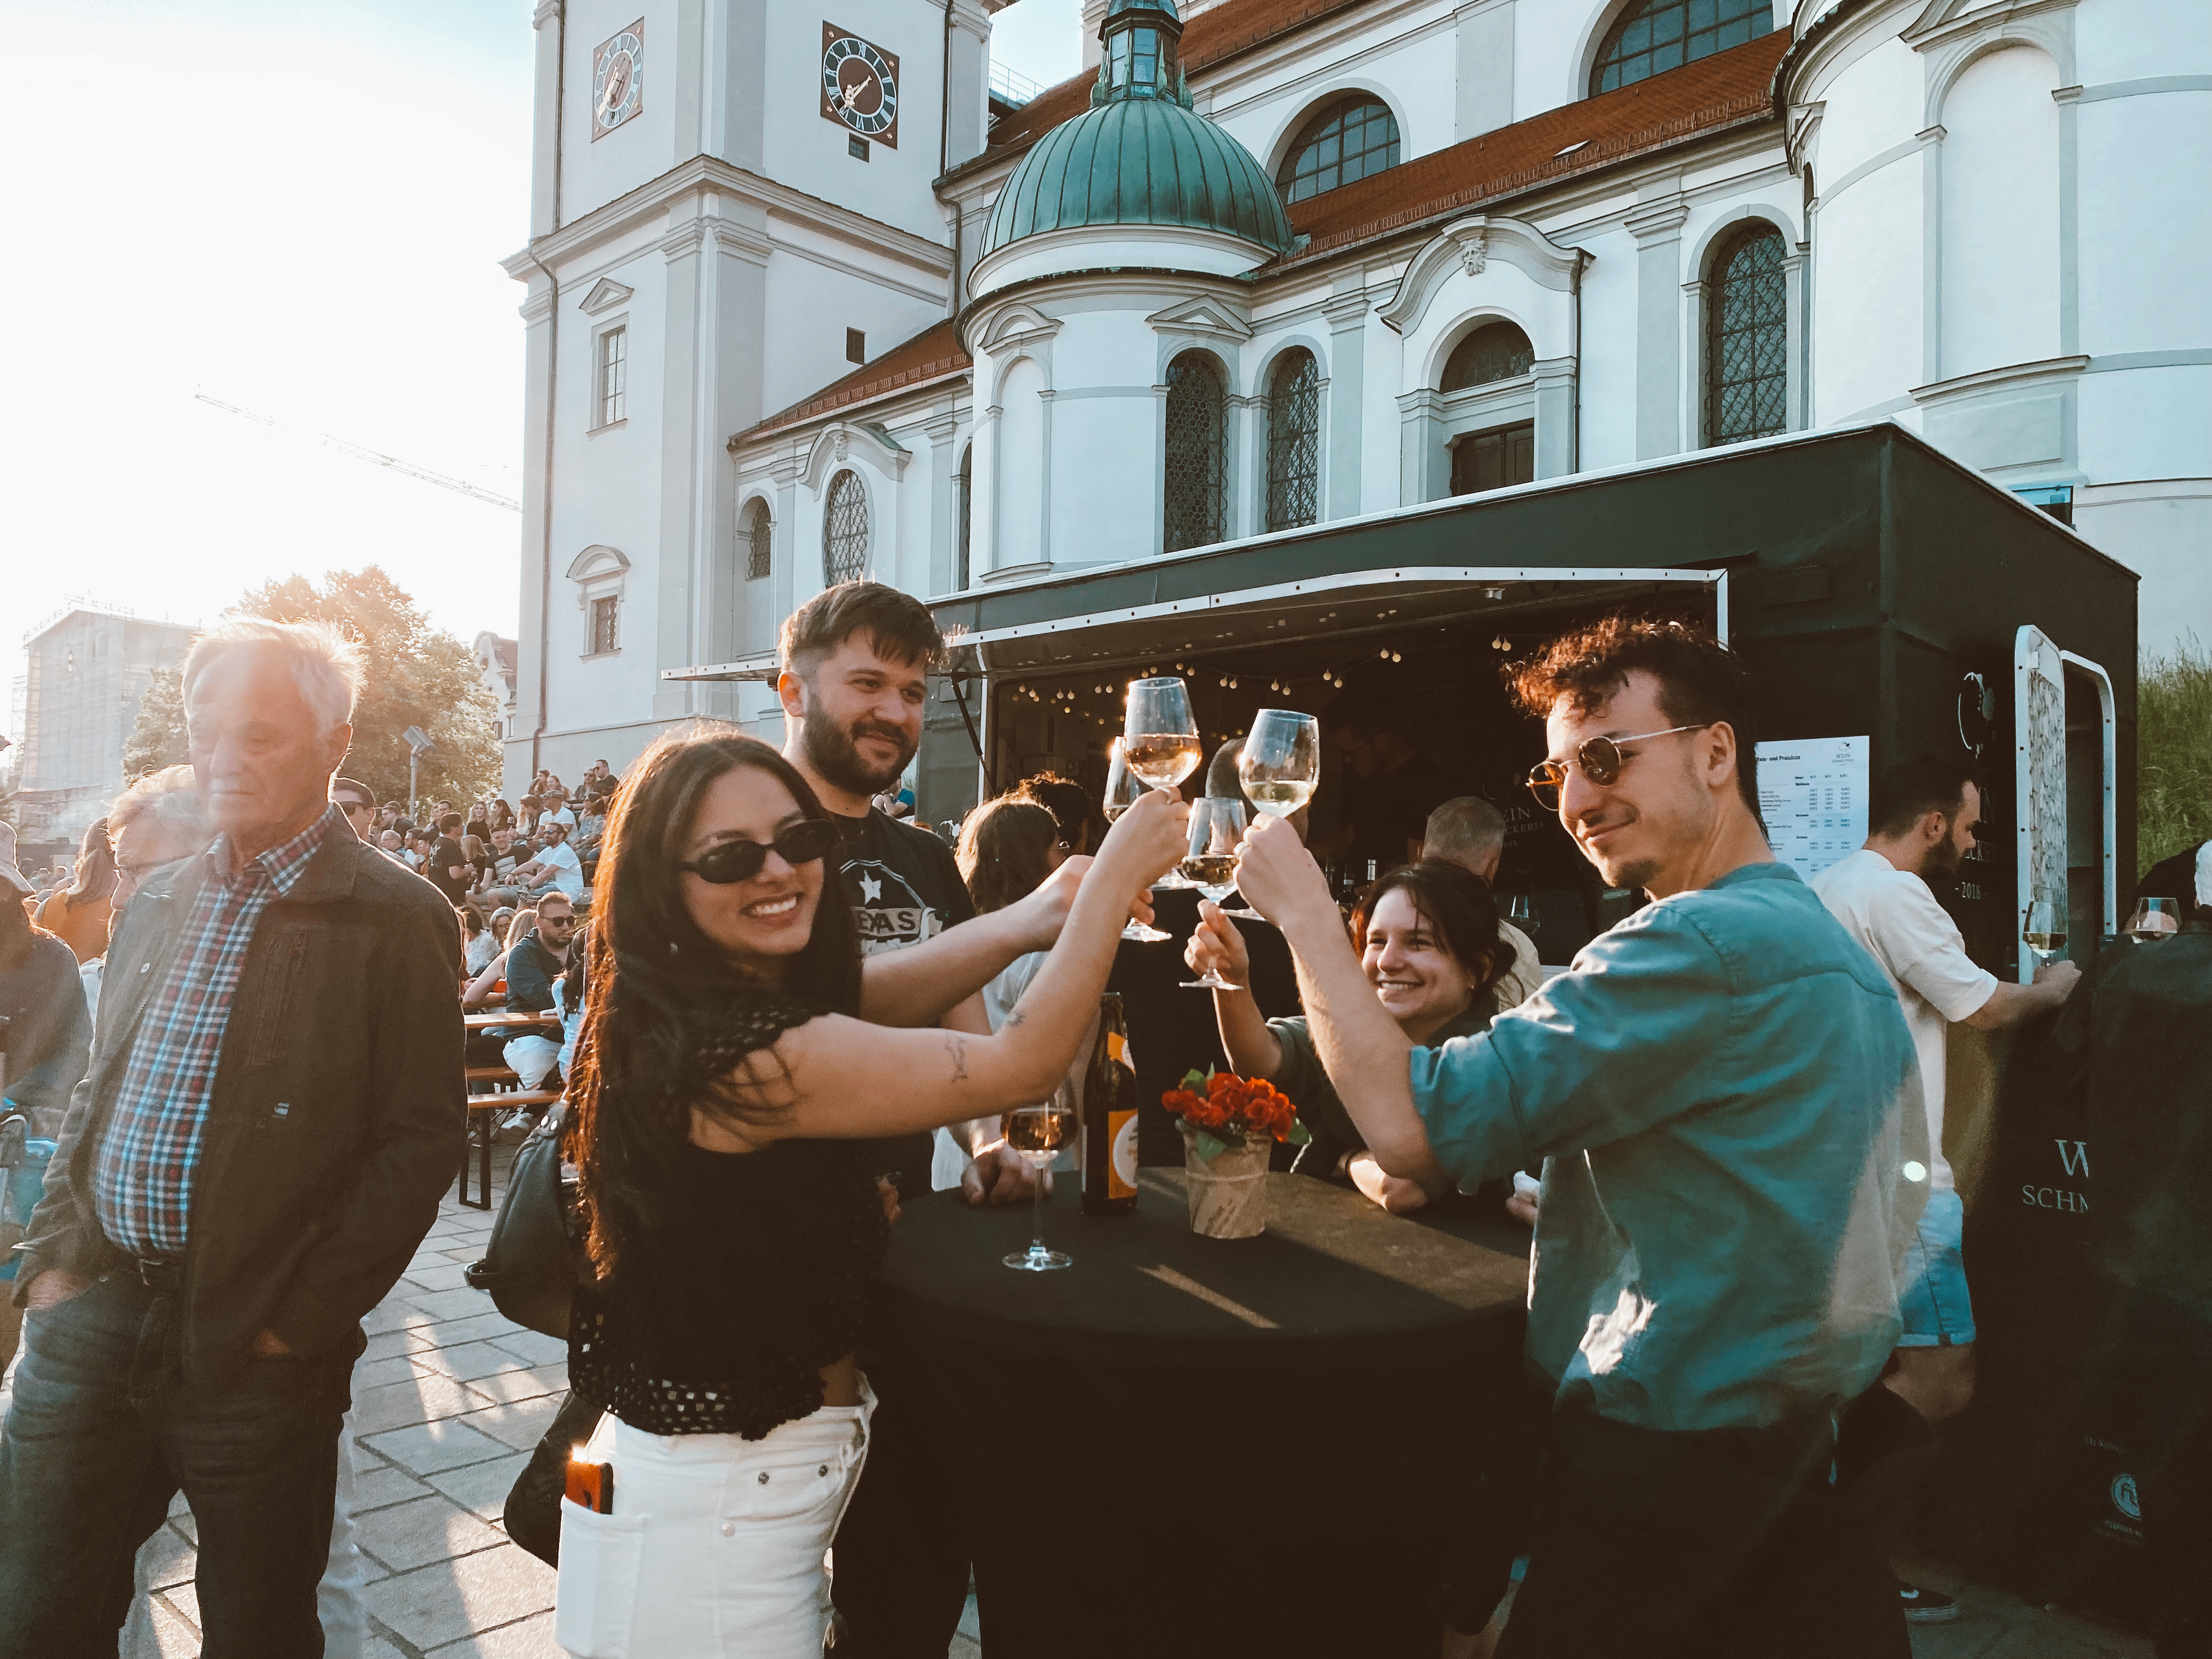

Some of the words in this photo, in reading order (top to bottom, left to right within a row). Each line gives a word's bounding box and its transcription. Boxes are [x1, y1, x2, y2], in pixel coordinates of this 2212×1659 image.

[1502, 806, 1530, 822] EIN
[1505, 821, 1544, 834] CKERIA
[1503, 840, 1518, 848] 018
[858, 911, 916, 933] EXAS
